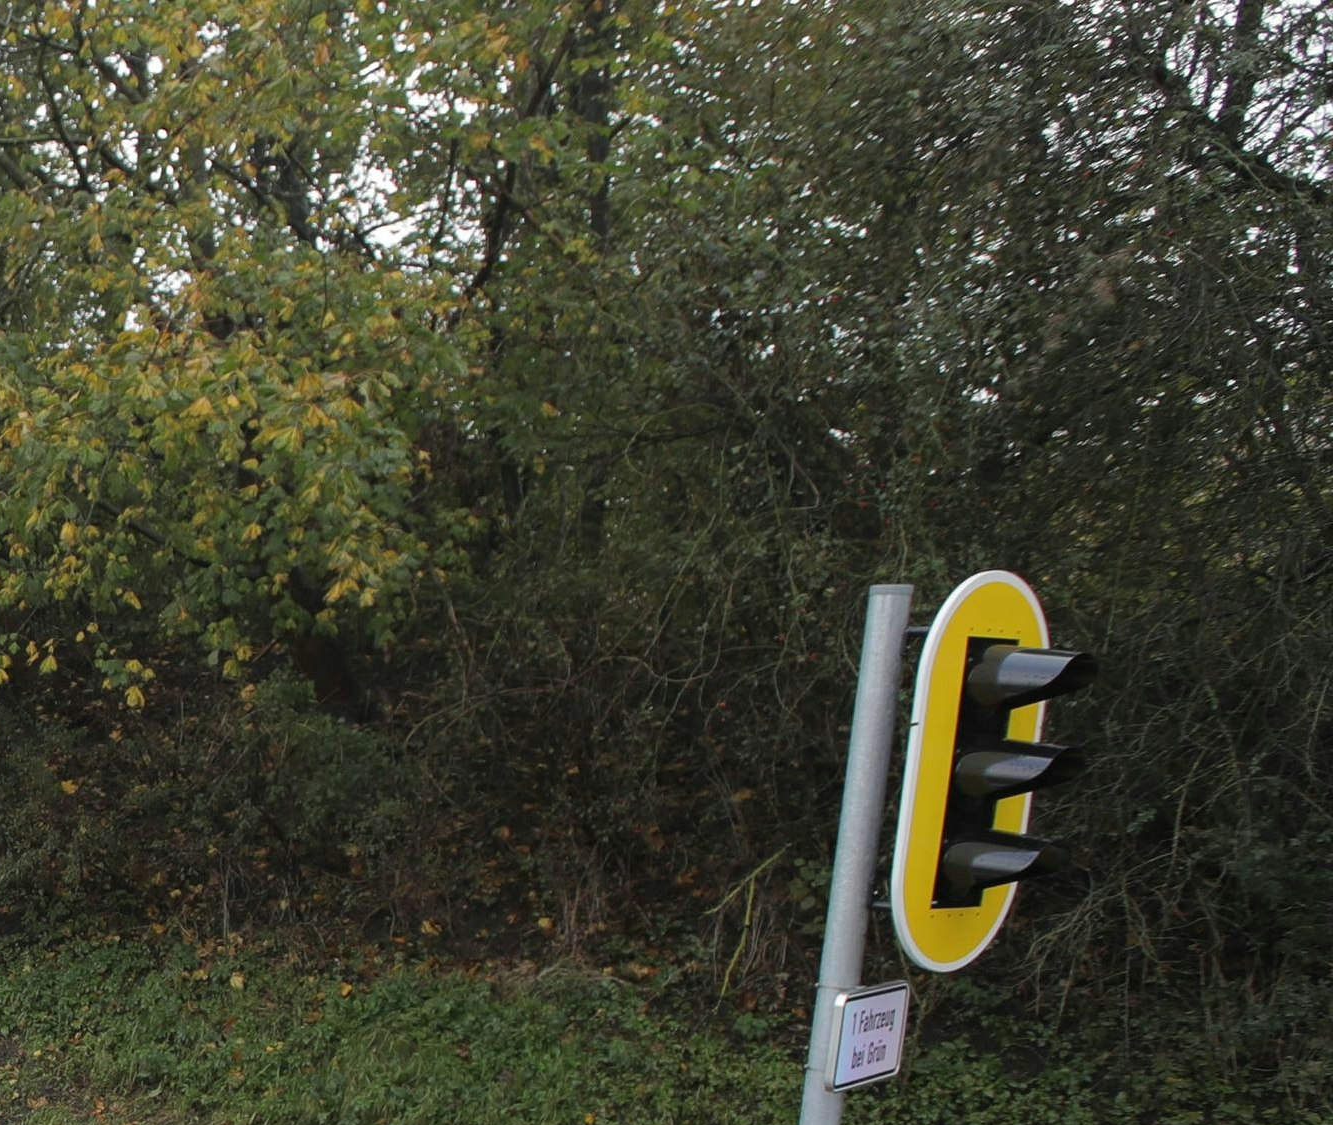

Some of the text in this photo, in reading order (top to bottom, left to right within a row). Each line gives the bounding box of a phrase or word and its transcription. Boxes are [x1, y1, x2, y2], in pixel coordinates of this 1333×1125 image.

[852, 1008, 896, 1036] 1 Fahrzeug
[850, 1043, 866, 1070] bei
